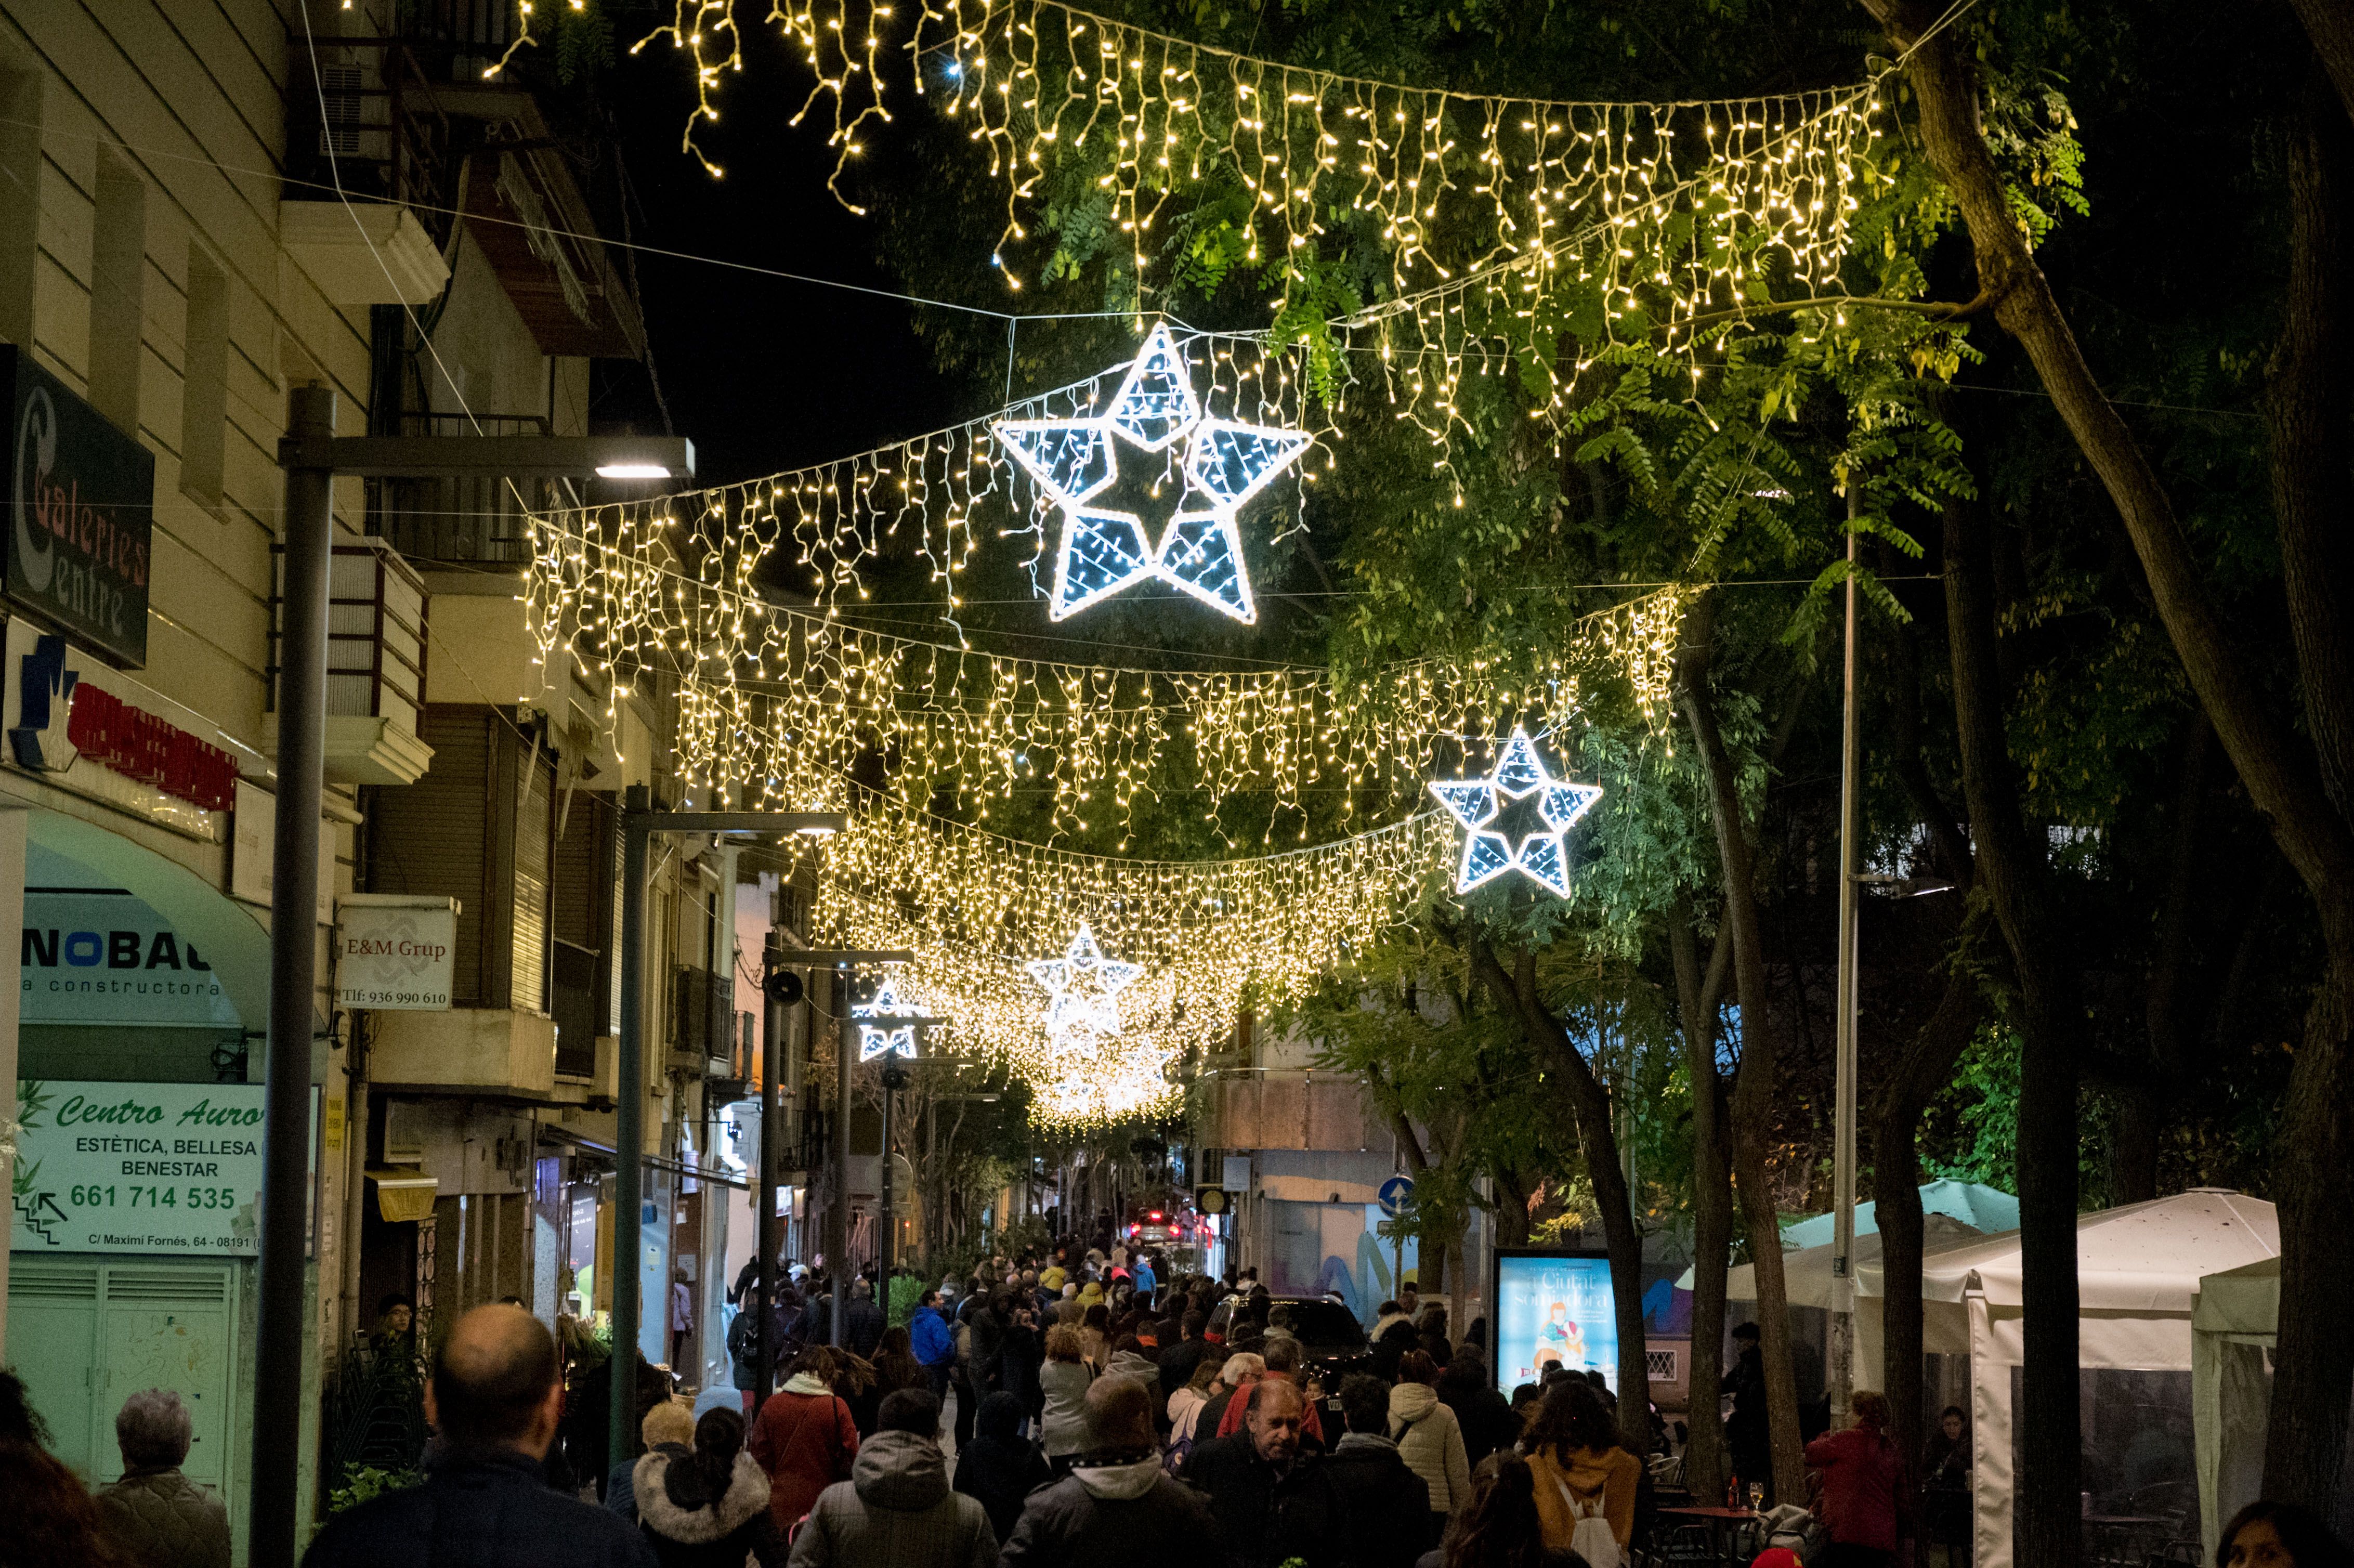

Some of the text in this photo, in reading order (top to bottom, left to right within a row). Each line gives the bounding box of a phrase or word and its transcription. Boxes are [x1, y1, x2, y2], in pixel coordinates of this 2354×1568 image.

[35, 467, 145, 586] Galeries
[348, 939, 446, 962] E&M Grup
[50, 979, 219, 996] constructora
[343, 989, 446, 1004] Tlf: 936 990 610
[56, 1095, 165, 1127] Centro
[76, 1134, 257, 1156] ESTÈTICA, BELLESA
[122, 1161, 218, 1177] BENESTAR
[71, 1185, 235, 1210] 661 714 535
[88, 1234, 101, 1245] C/
[103, 1234, 144, 1246] Maximí
[148, 1236, 190, 1248] Fornés,
[193, 1237, 207, 1247] 64
[217, 1237, 249, 1247] 08191
[1542, 1272, 1597, 1290] Ciutat
